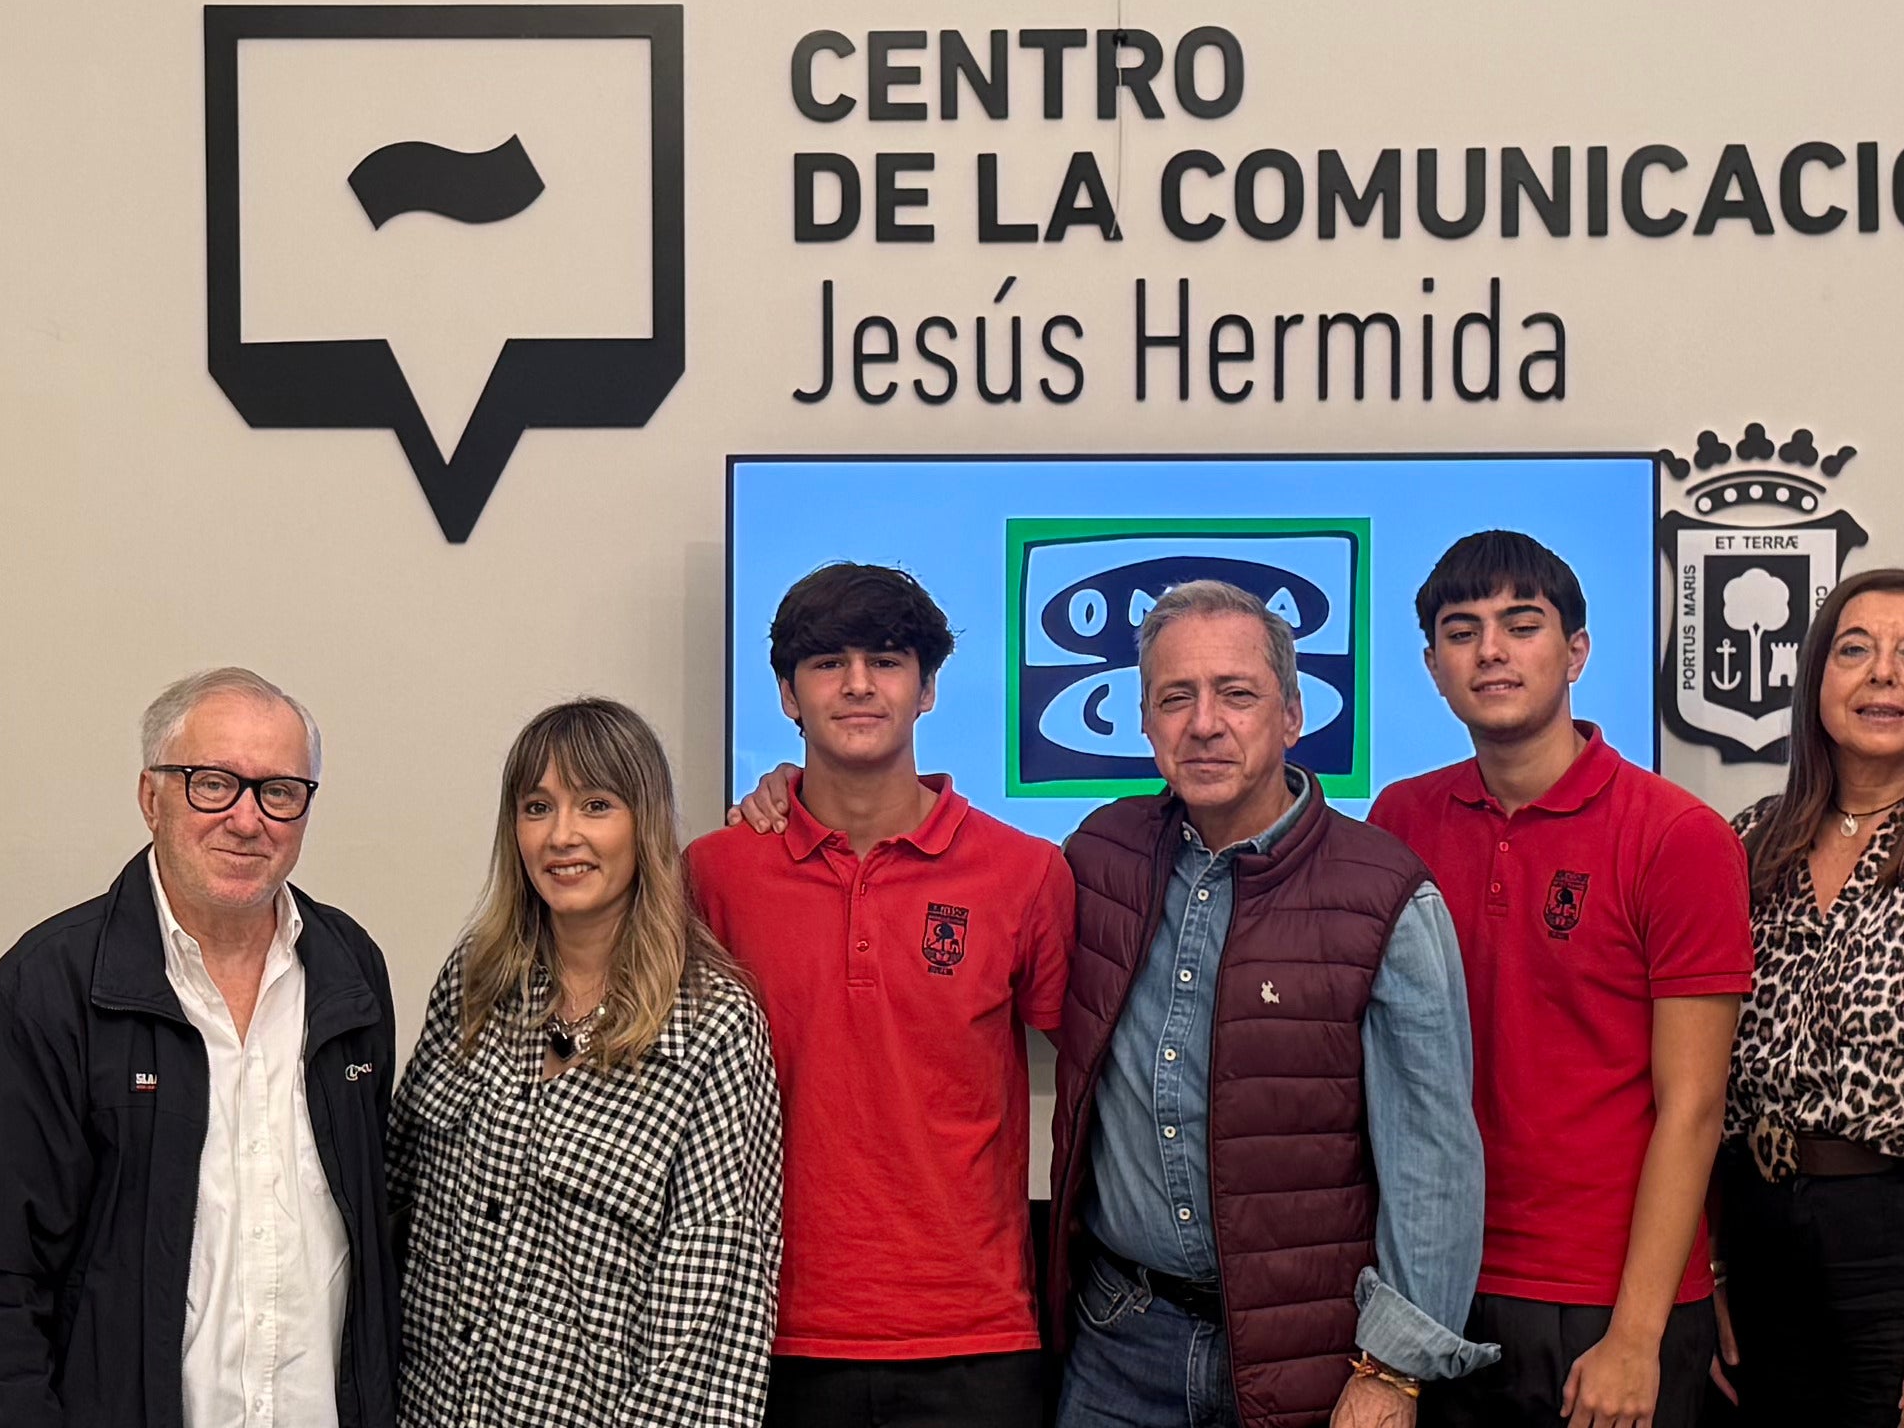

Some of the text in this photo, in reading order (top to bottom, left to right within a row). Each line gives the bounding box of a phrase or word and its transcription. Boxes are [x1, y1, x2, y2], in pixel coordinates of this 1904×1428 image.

[790, 25, 1245, 124] CENTRO
[793, 152, 935, 244] DE
[976, 151, 1124, 244] LA
[792, 275, 1566, 407] Jesús Hermida
[1715, 536, 1735, 549] ET
[1683, 564, 1696, 691] PORTUS MARIS
